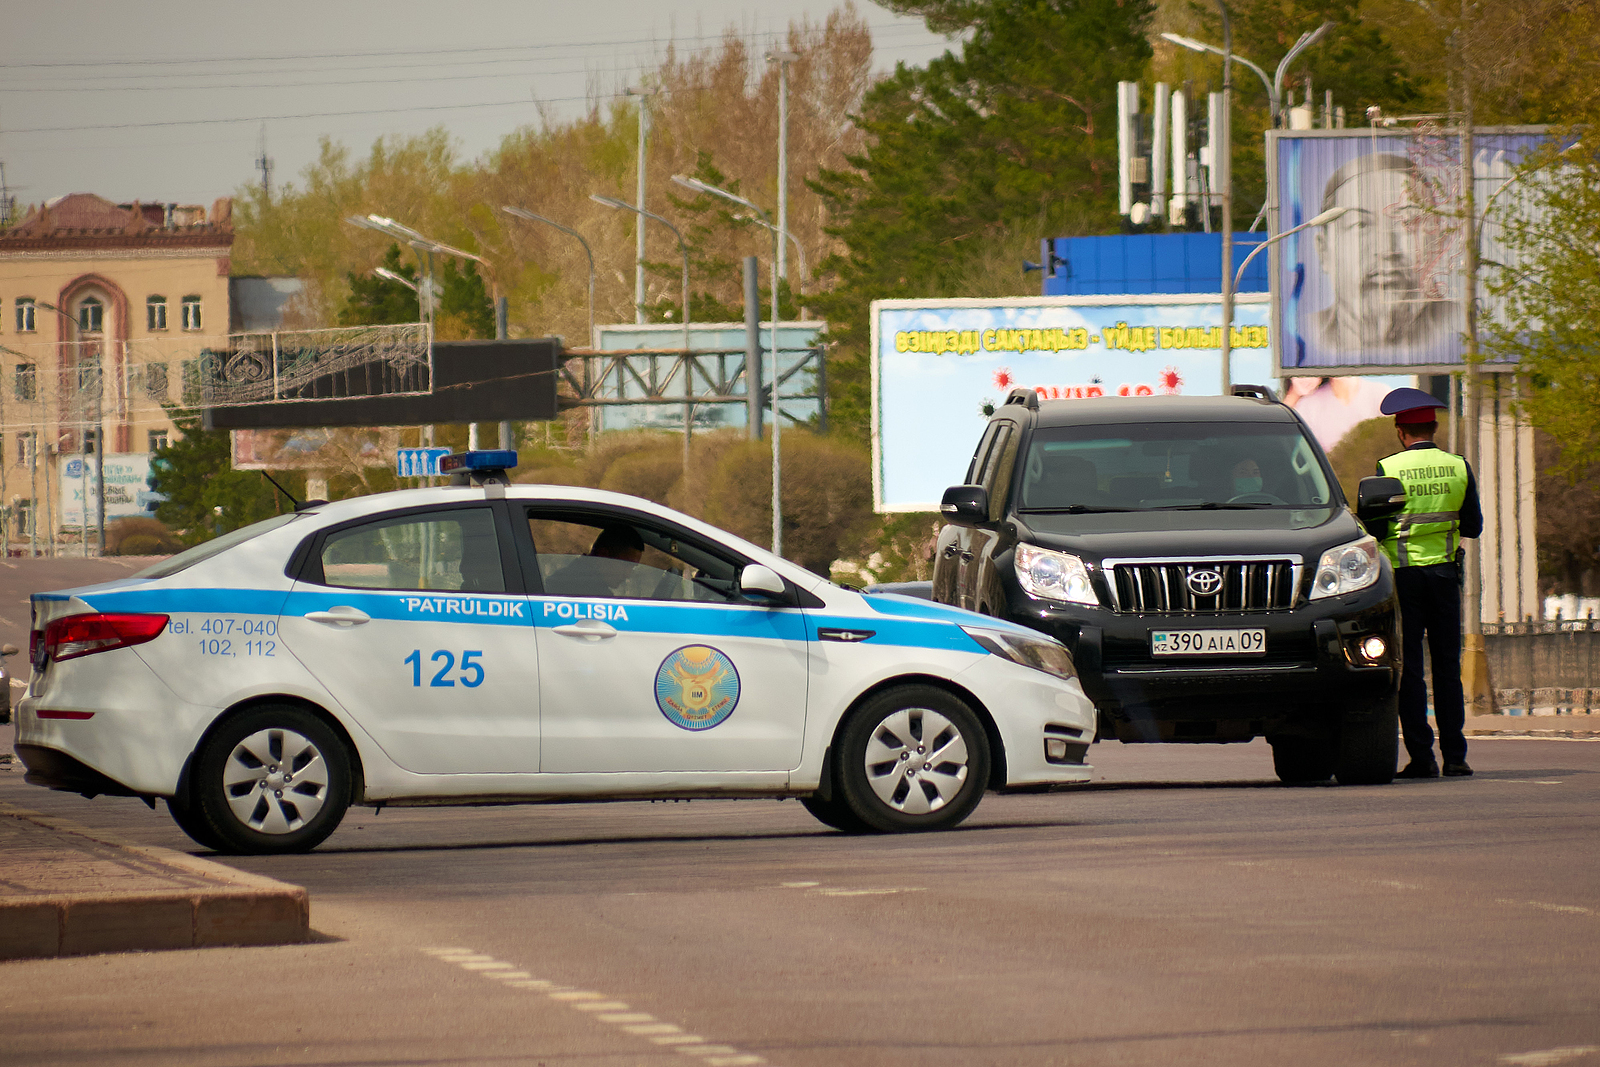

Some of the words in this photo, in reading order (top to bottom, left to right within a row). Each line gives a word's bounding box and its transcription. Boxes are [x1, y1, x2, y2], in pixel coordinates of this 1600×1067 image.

[1399, 465, 1457, 481] PATRÚLDIK
[1409, 482, 1451, 497] POLISIA
[543, 602, 629, 621] POLISIA
[168, 618, 194, 634] tel.
[200, 618, 277, 636] 407-040
[199, 639, 236, 658] 102,
[245, 640, 276, 657] 112
[1154, 643, 1168, 652] KZ
[1169, 633, 1203, 651] 390
[1207, 636, 1236, 651] AIA
[1241, 631, 1263, 650] 09
[403, 649, 485, 688] 125
